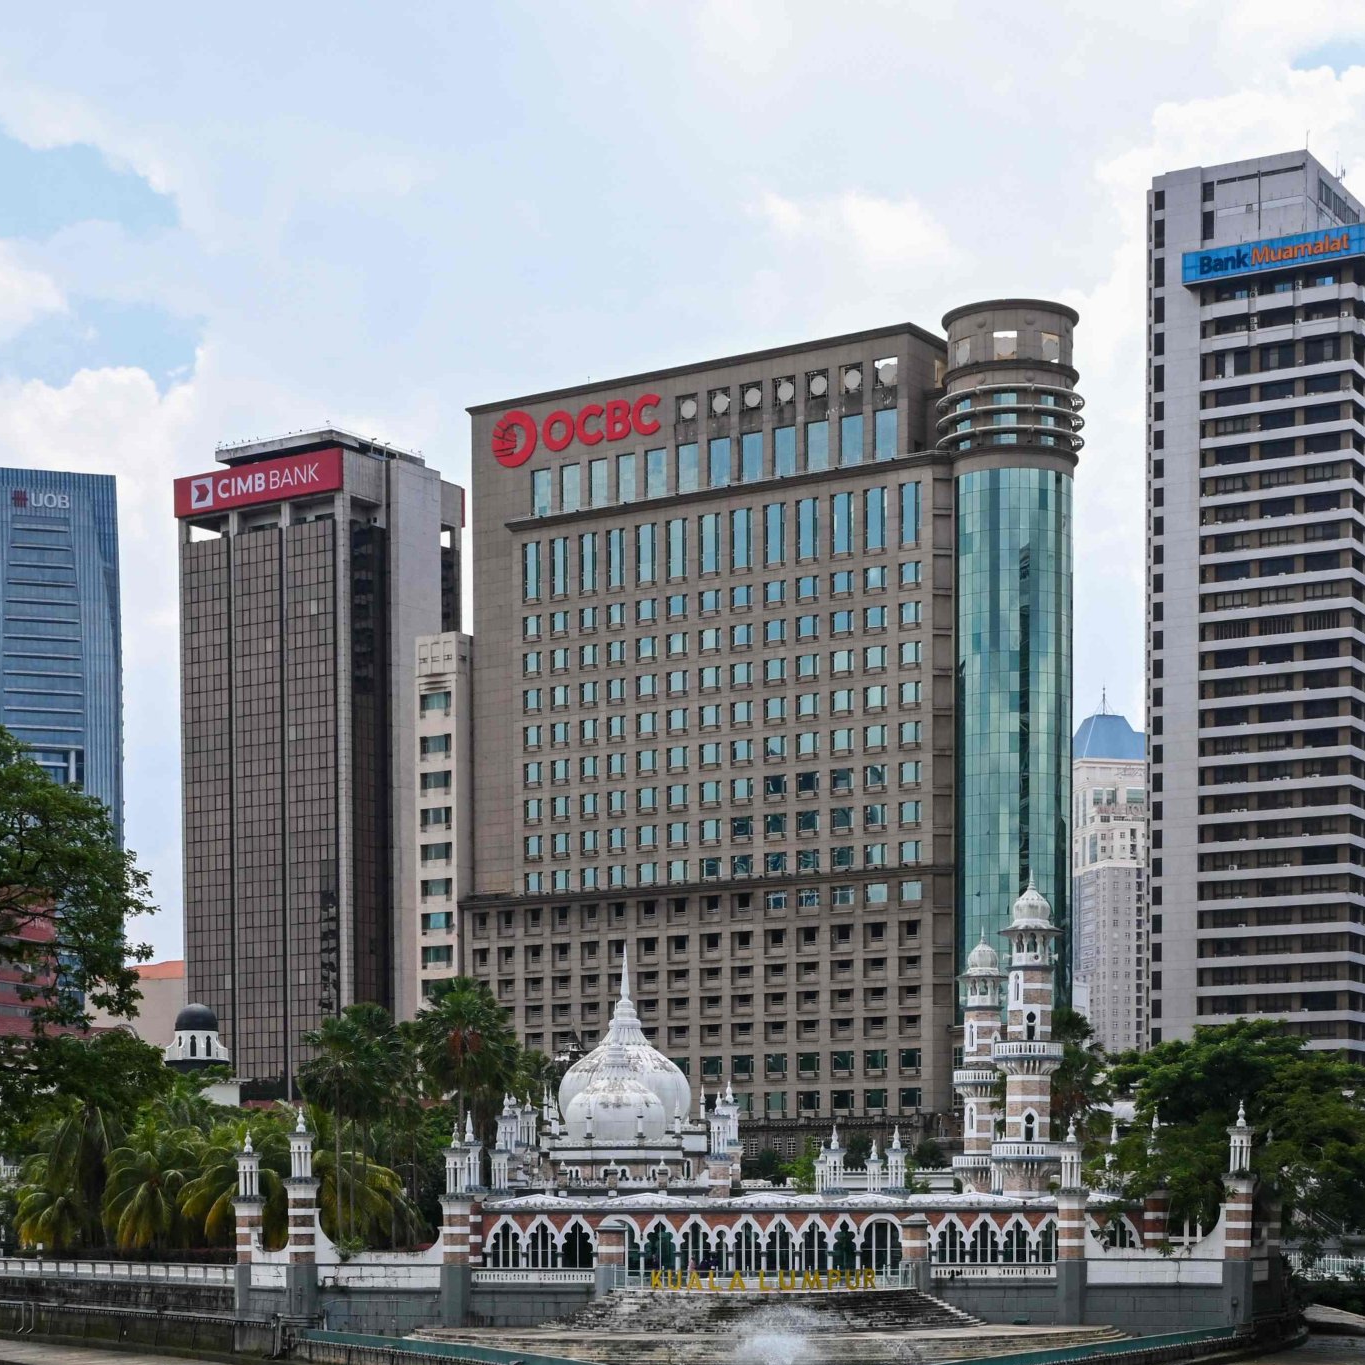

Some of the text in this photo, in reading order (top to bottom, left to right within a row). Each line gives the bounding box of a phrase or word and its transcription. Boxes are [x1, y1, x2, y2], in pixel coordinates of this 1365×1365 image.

[1198, 234, 1350, 276] Bank Muamalat
[542, 393, 662, 452] OCBC
[217, 462, 320, 500] CIMB BANK
[31, 492, 70, 509] UOB
[650, 1268, 878, 1292] KUALA LUMPUR
